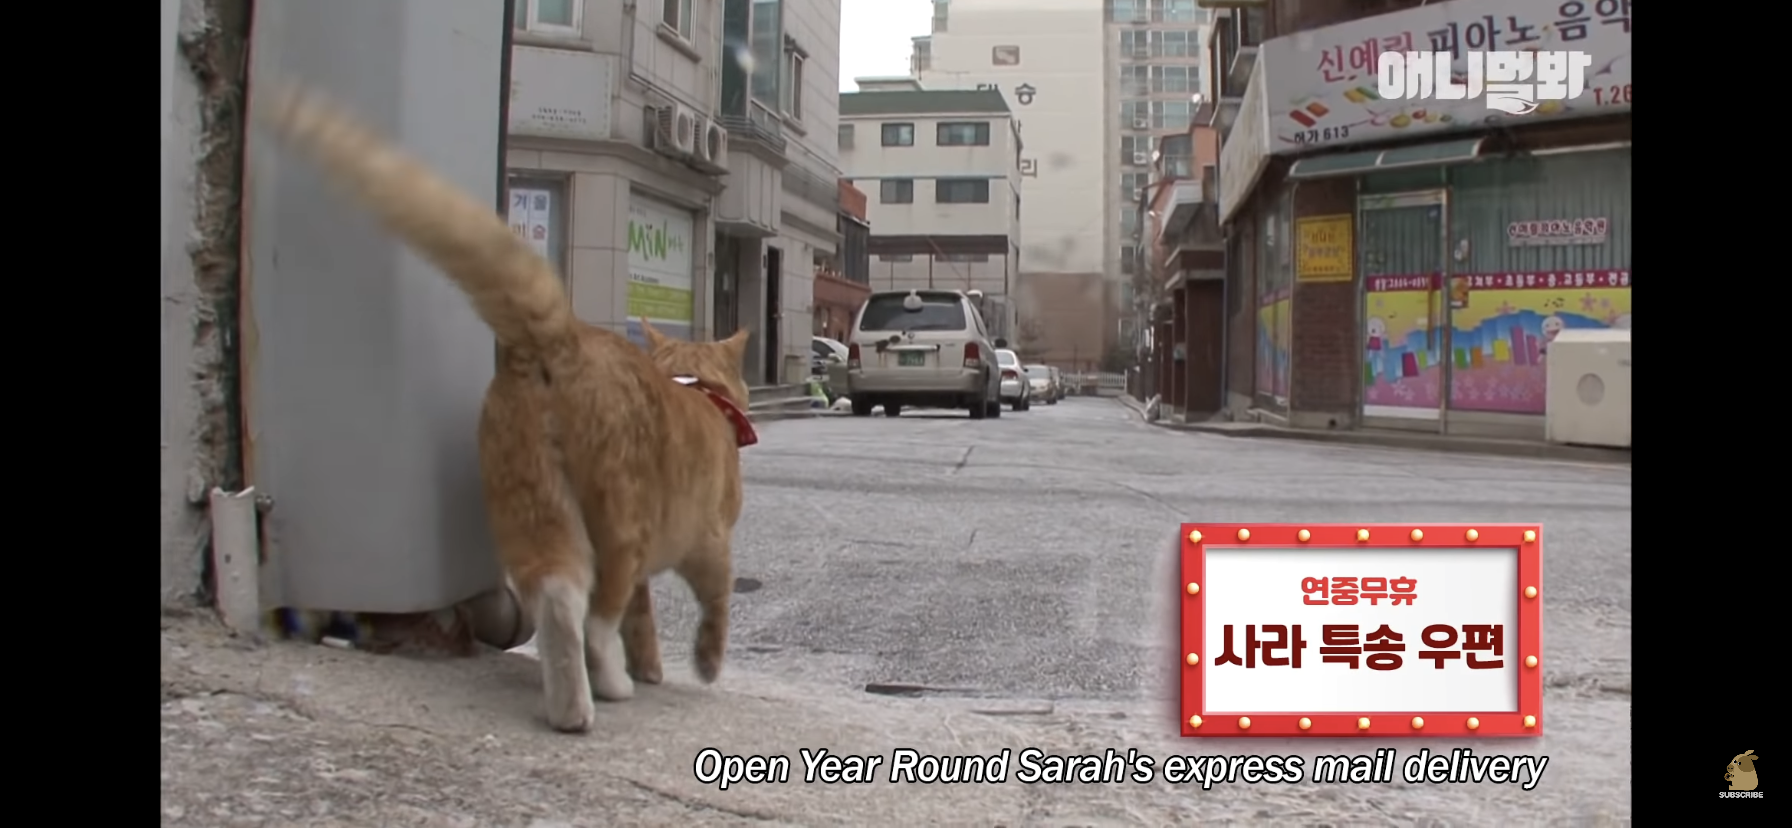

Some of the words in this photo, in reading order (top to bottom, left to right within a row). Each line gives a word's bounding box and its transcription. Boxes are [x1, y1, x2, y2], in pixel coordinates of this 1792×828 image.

[1427, 14, 1541, 61] 피아노
[1553, 0, 1631, 42] 음악
[1323, 125, 1349, 140] 613
